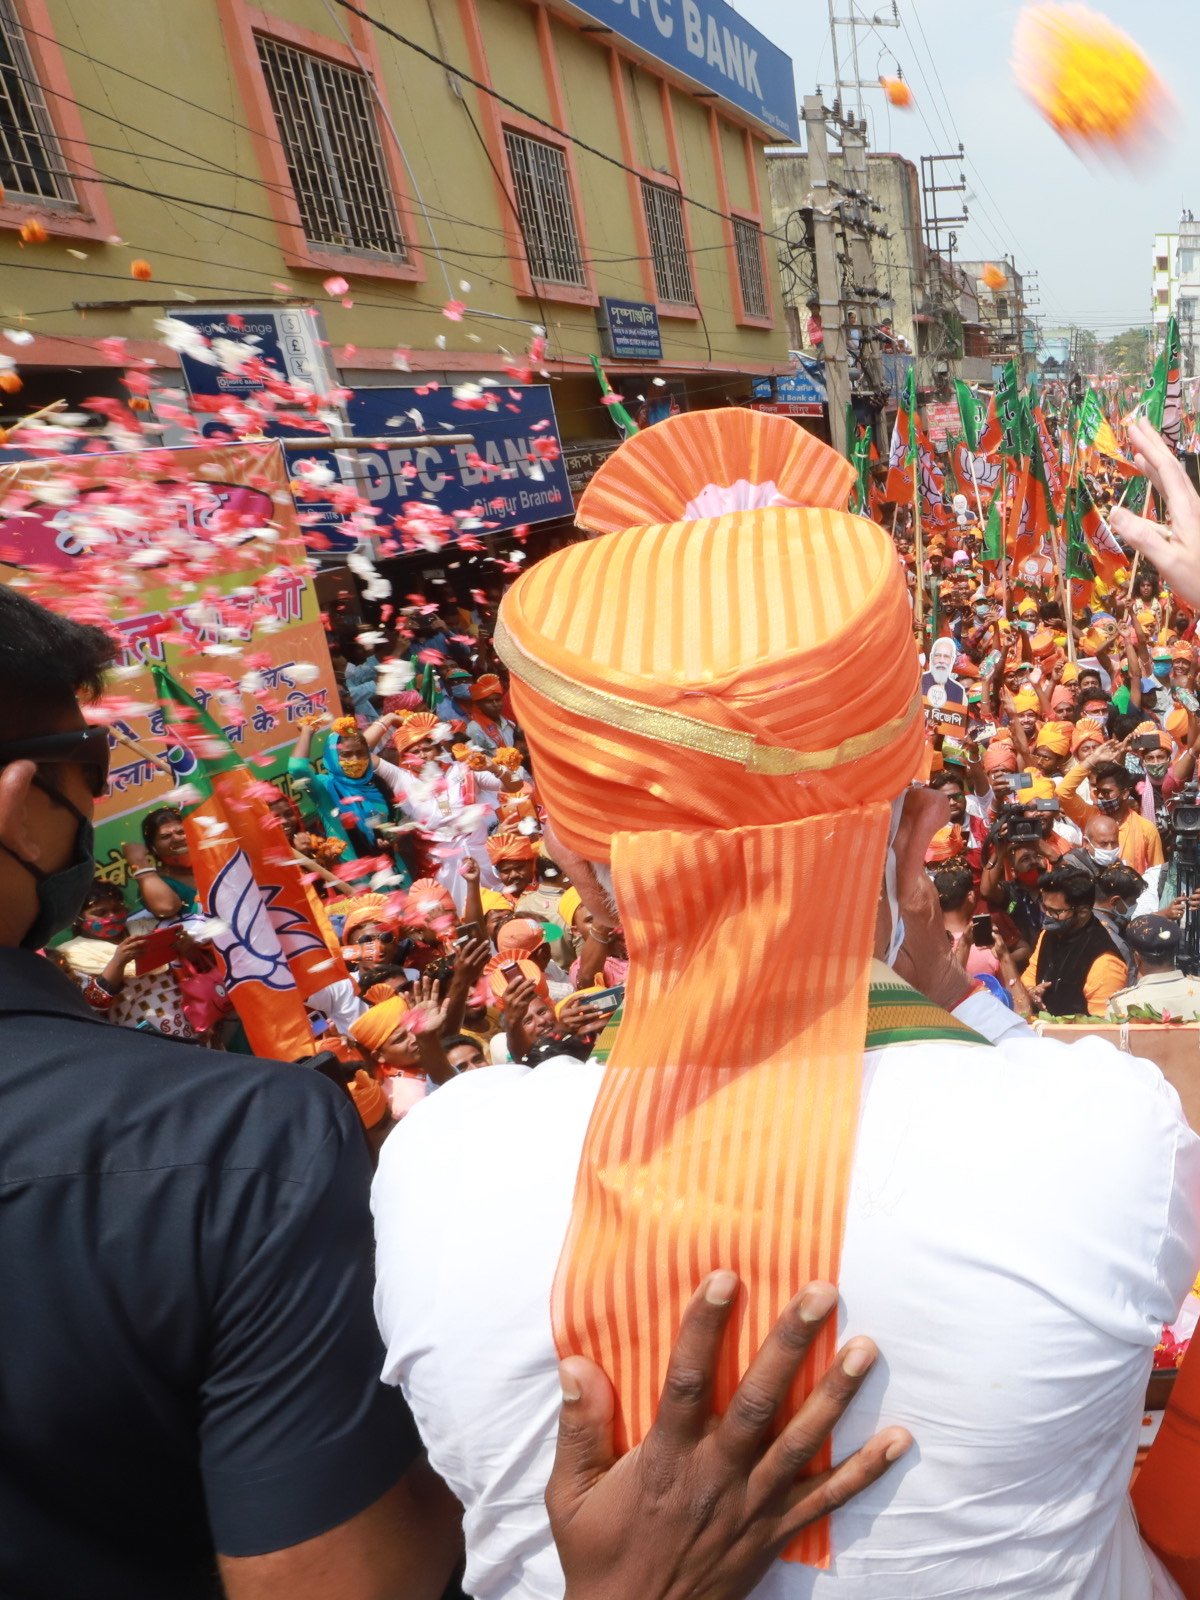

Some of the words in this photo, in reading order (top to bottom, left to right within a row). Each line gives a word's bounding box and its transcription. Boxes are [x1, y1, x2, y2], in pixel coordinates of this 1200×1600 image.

[681, 0, 764, 100] BANK
[361, 446, 446, 501] DFC
[455, 435, 556, 487] BANK
[521, 485, 562, 509] Branch
[285, 688, 329, 723] लिए
[932, 708, 962, 726] বিজেপি
